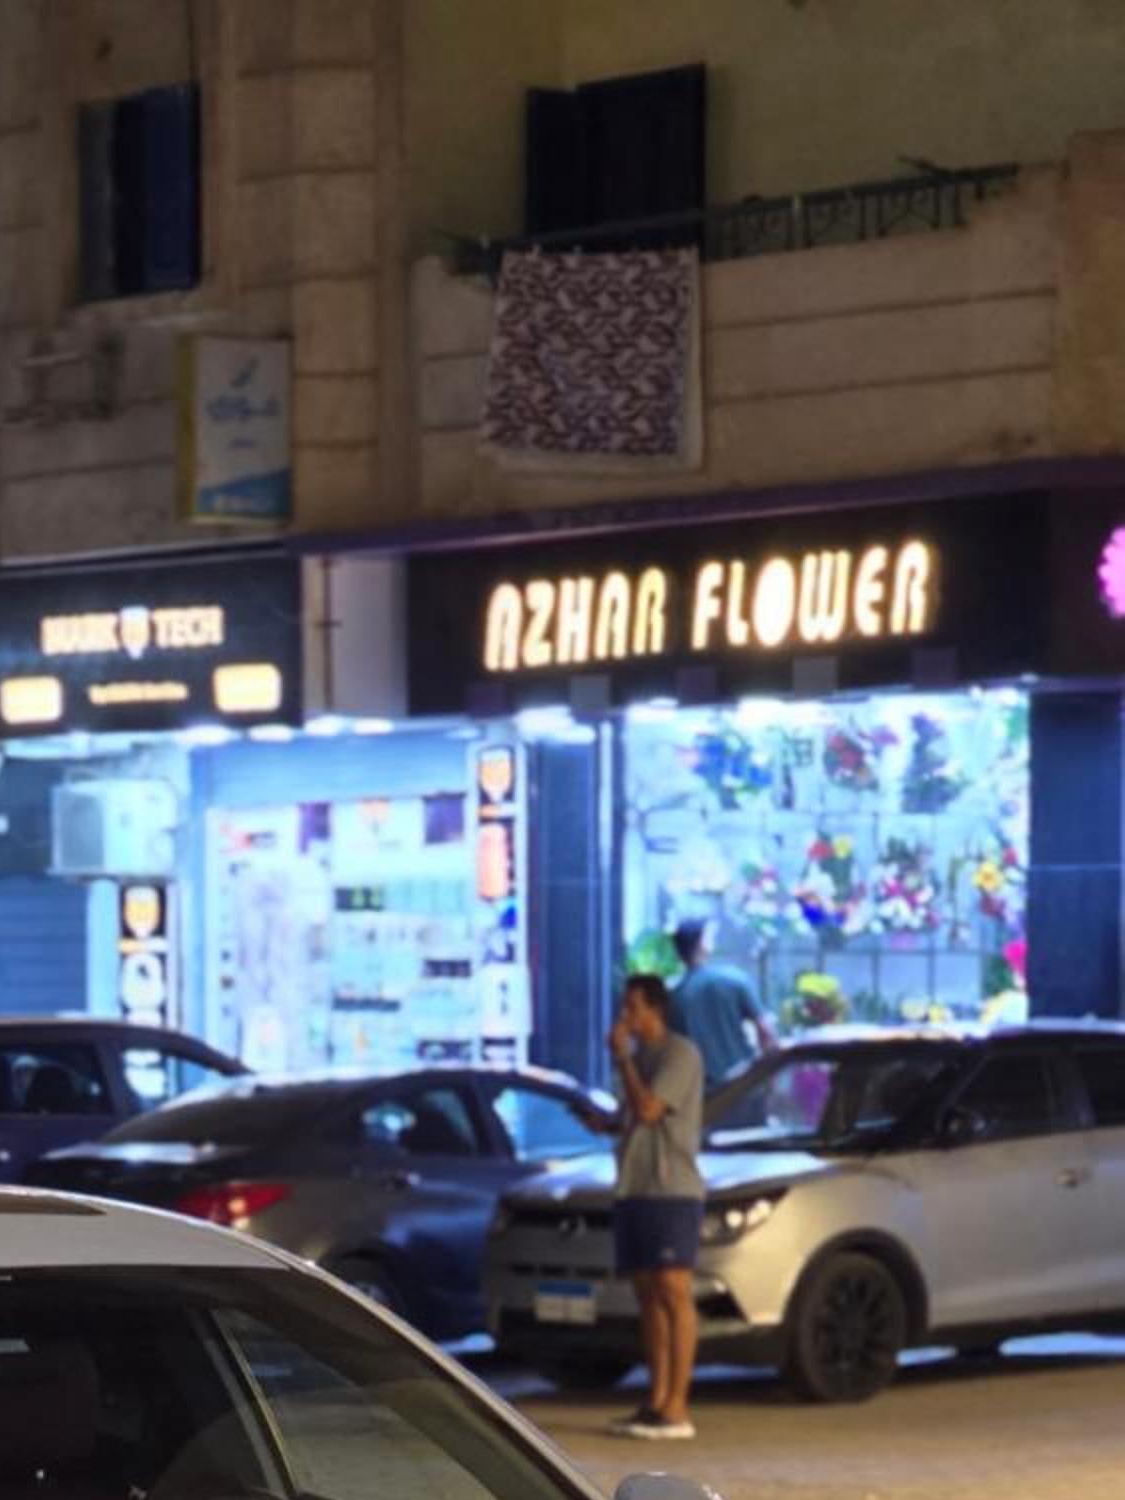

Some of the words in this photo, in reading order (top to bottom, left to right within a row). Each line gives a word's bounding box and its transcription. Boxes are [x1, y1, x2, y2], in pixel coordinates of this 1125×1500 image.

[151, 605, 225, 649] TECH
[483, 566, 667, 672] AZHAR
[690, 539, 931, 651] FLOWER
